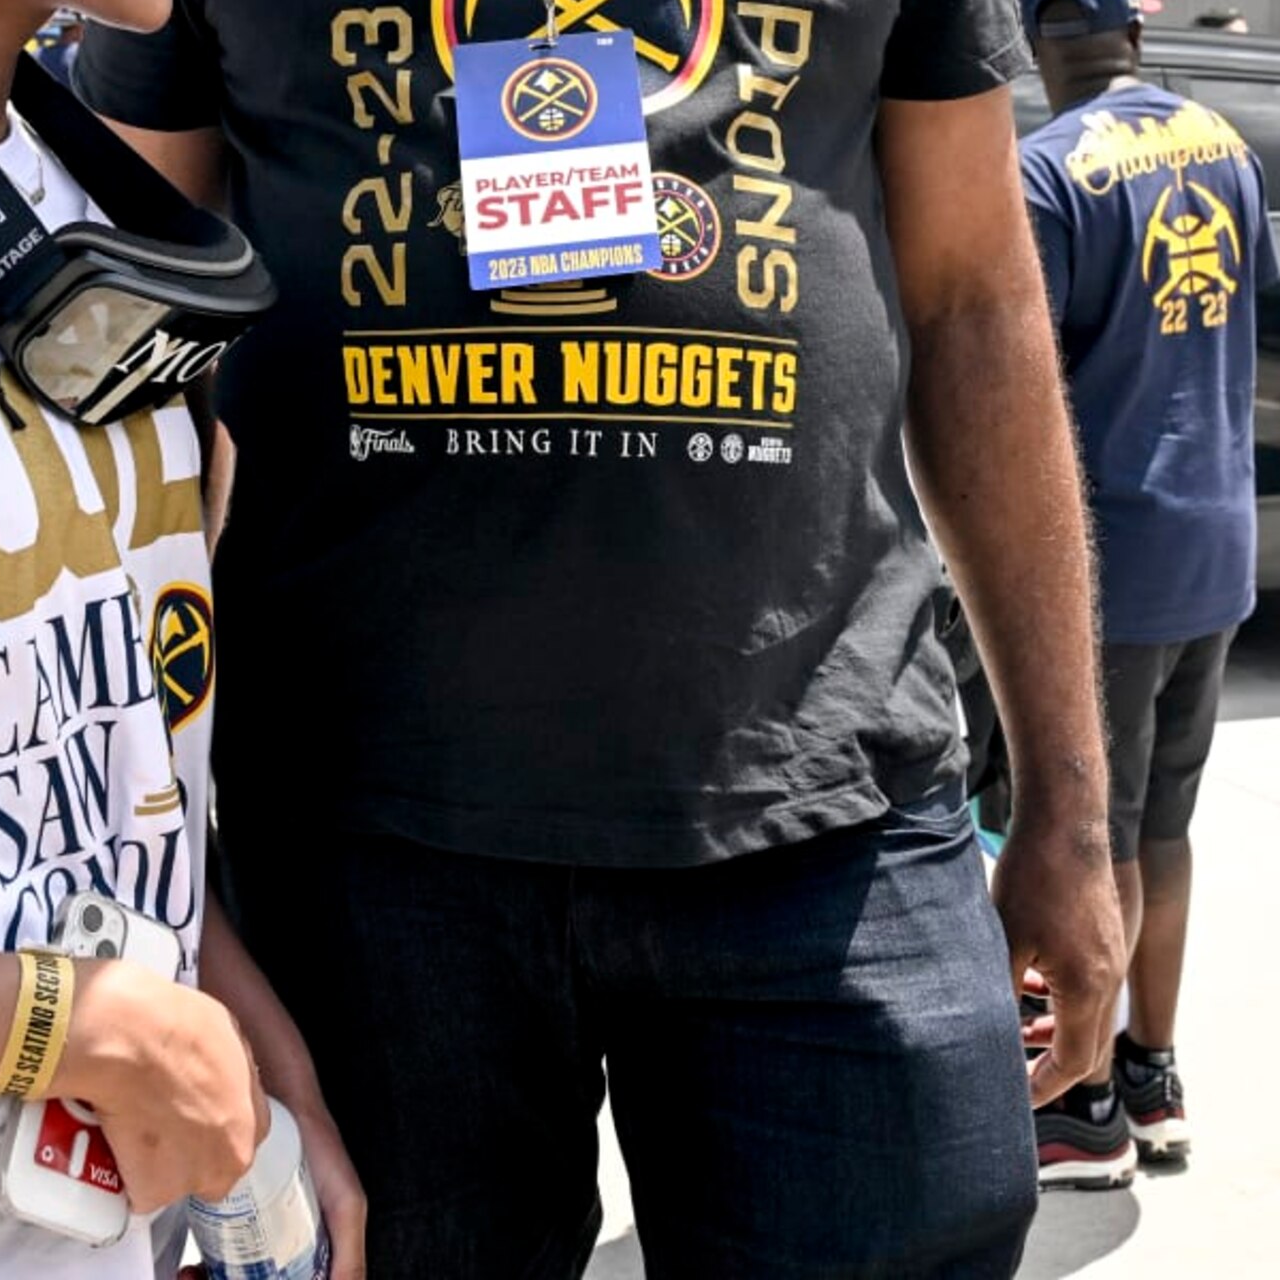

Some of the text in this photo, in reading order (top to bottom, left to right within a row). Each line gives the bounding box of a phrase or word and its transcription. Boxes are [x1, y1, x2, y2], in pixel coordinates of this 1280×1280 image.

[331, 4, 414, 308] 22-23
[475, 162, 640, 194] PLAYER/TEAM
[477, 182, 643, 230] STAFF
[488, 255, 527, 281] 2023
[529, 252, 558, 276] NBA
[560, 243, 644, 273] CHAMPIONS
[1160, 292, 1228, 335] 22 23
[342, 340, 798, 414] DENVER NUGGETS
[446, 428, 552, 456] BRING
[569, 430, 603, 455] IT
[621, 431, 658, 458] IN
[16, 1006, 56, 1074] SEATING
[89, 1162, 119, 1190] VISA
